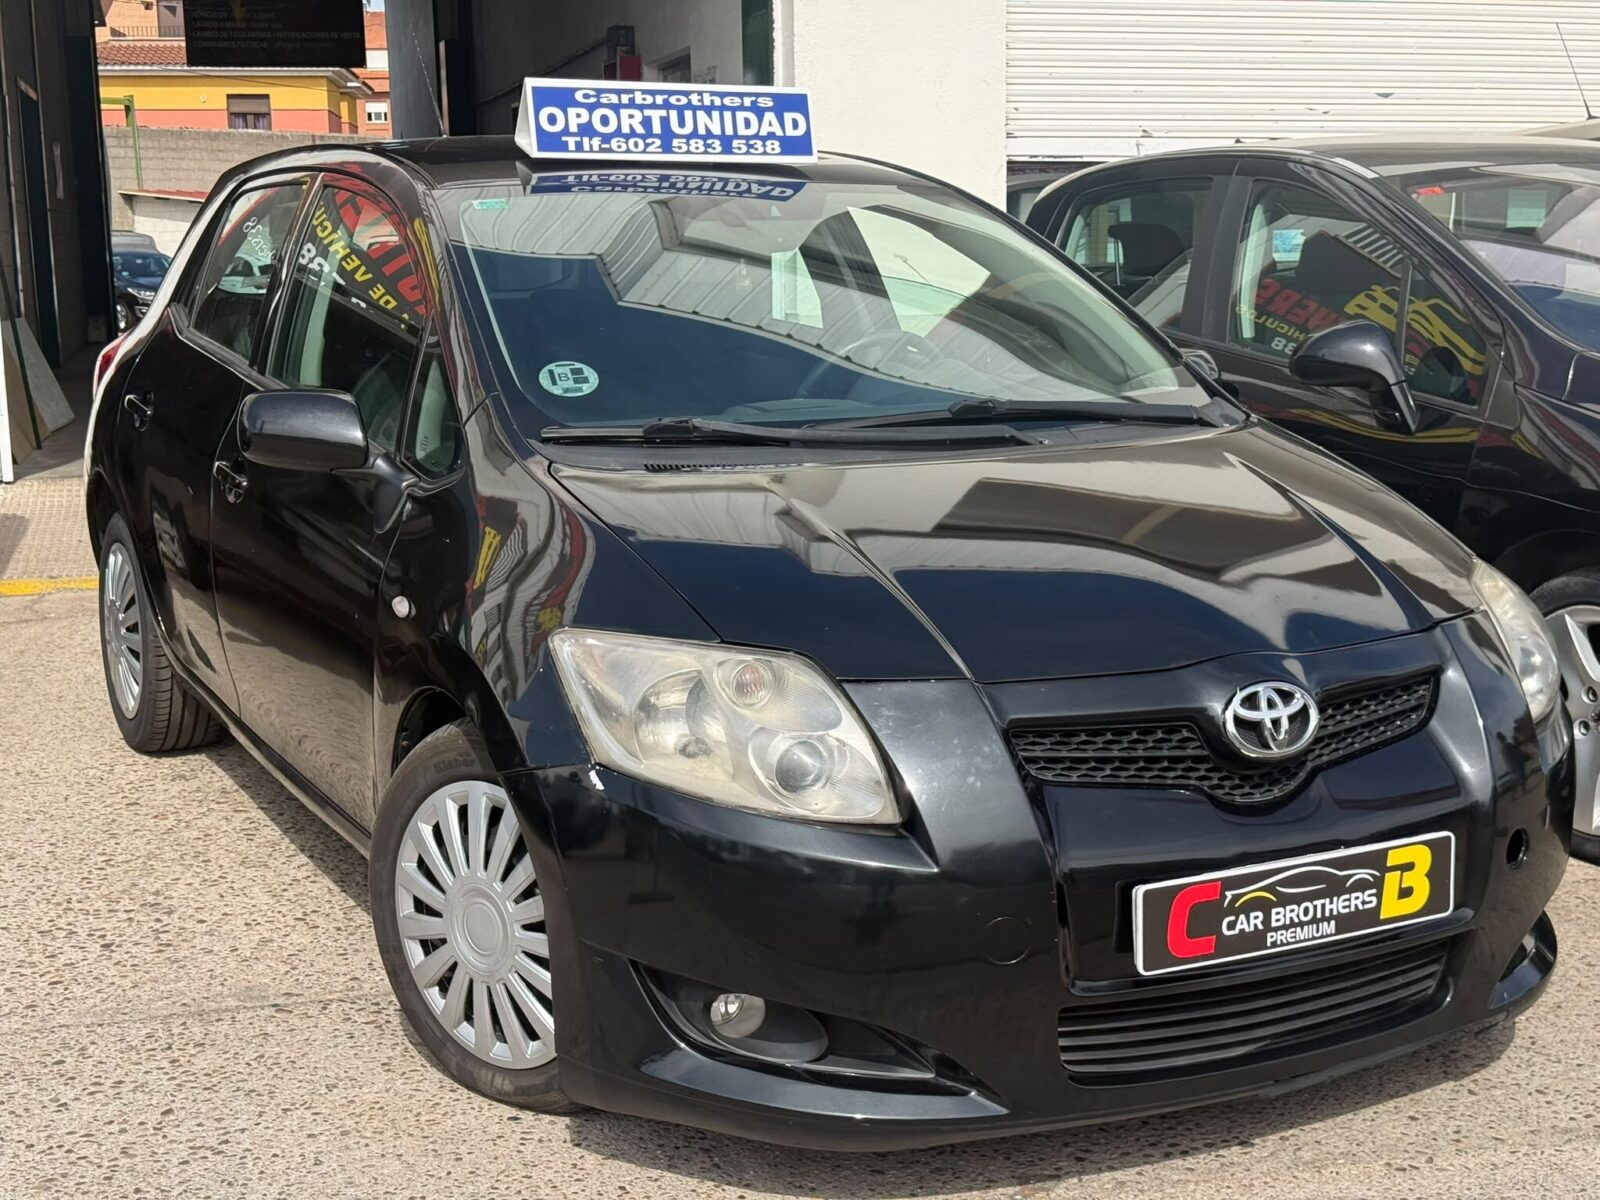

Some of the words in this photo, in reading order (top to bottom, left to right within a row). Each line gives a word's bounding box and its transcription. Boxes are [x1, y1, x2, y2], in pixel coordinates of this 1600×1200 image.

[574, 89, 774, 107] Carbrothers
[538, 106, 807, 137] OPORTUNIDAD
[562, 136, 662, 153] Tlf-602
[671, 138, 722, 154] 583
[731, 139, 781, 154] 538
[558, 372, 570, 382] B
[1379, 844, 1432, 920] B
[1167, 881, 1222, 958] C
[1221, 911, 1264, 936] CAR
[1271, 889, 1378, 927] BROTHERS
[1267, 920, 1336, 947] PREMIUM
